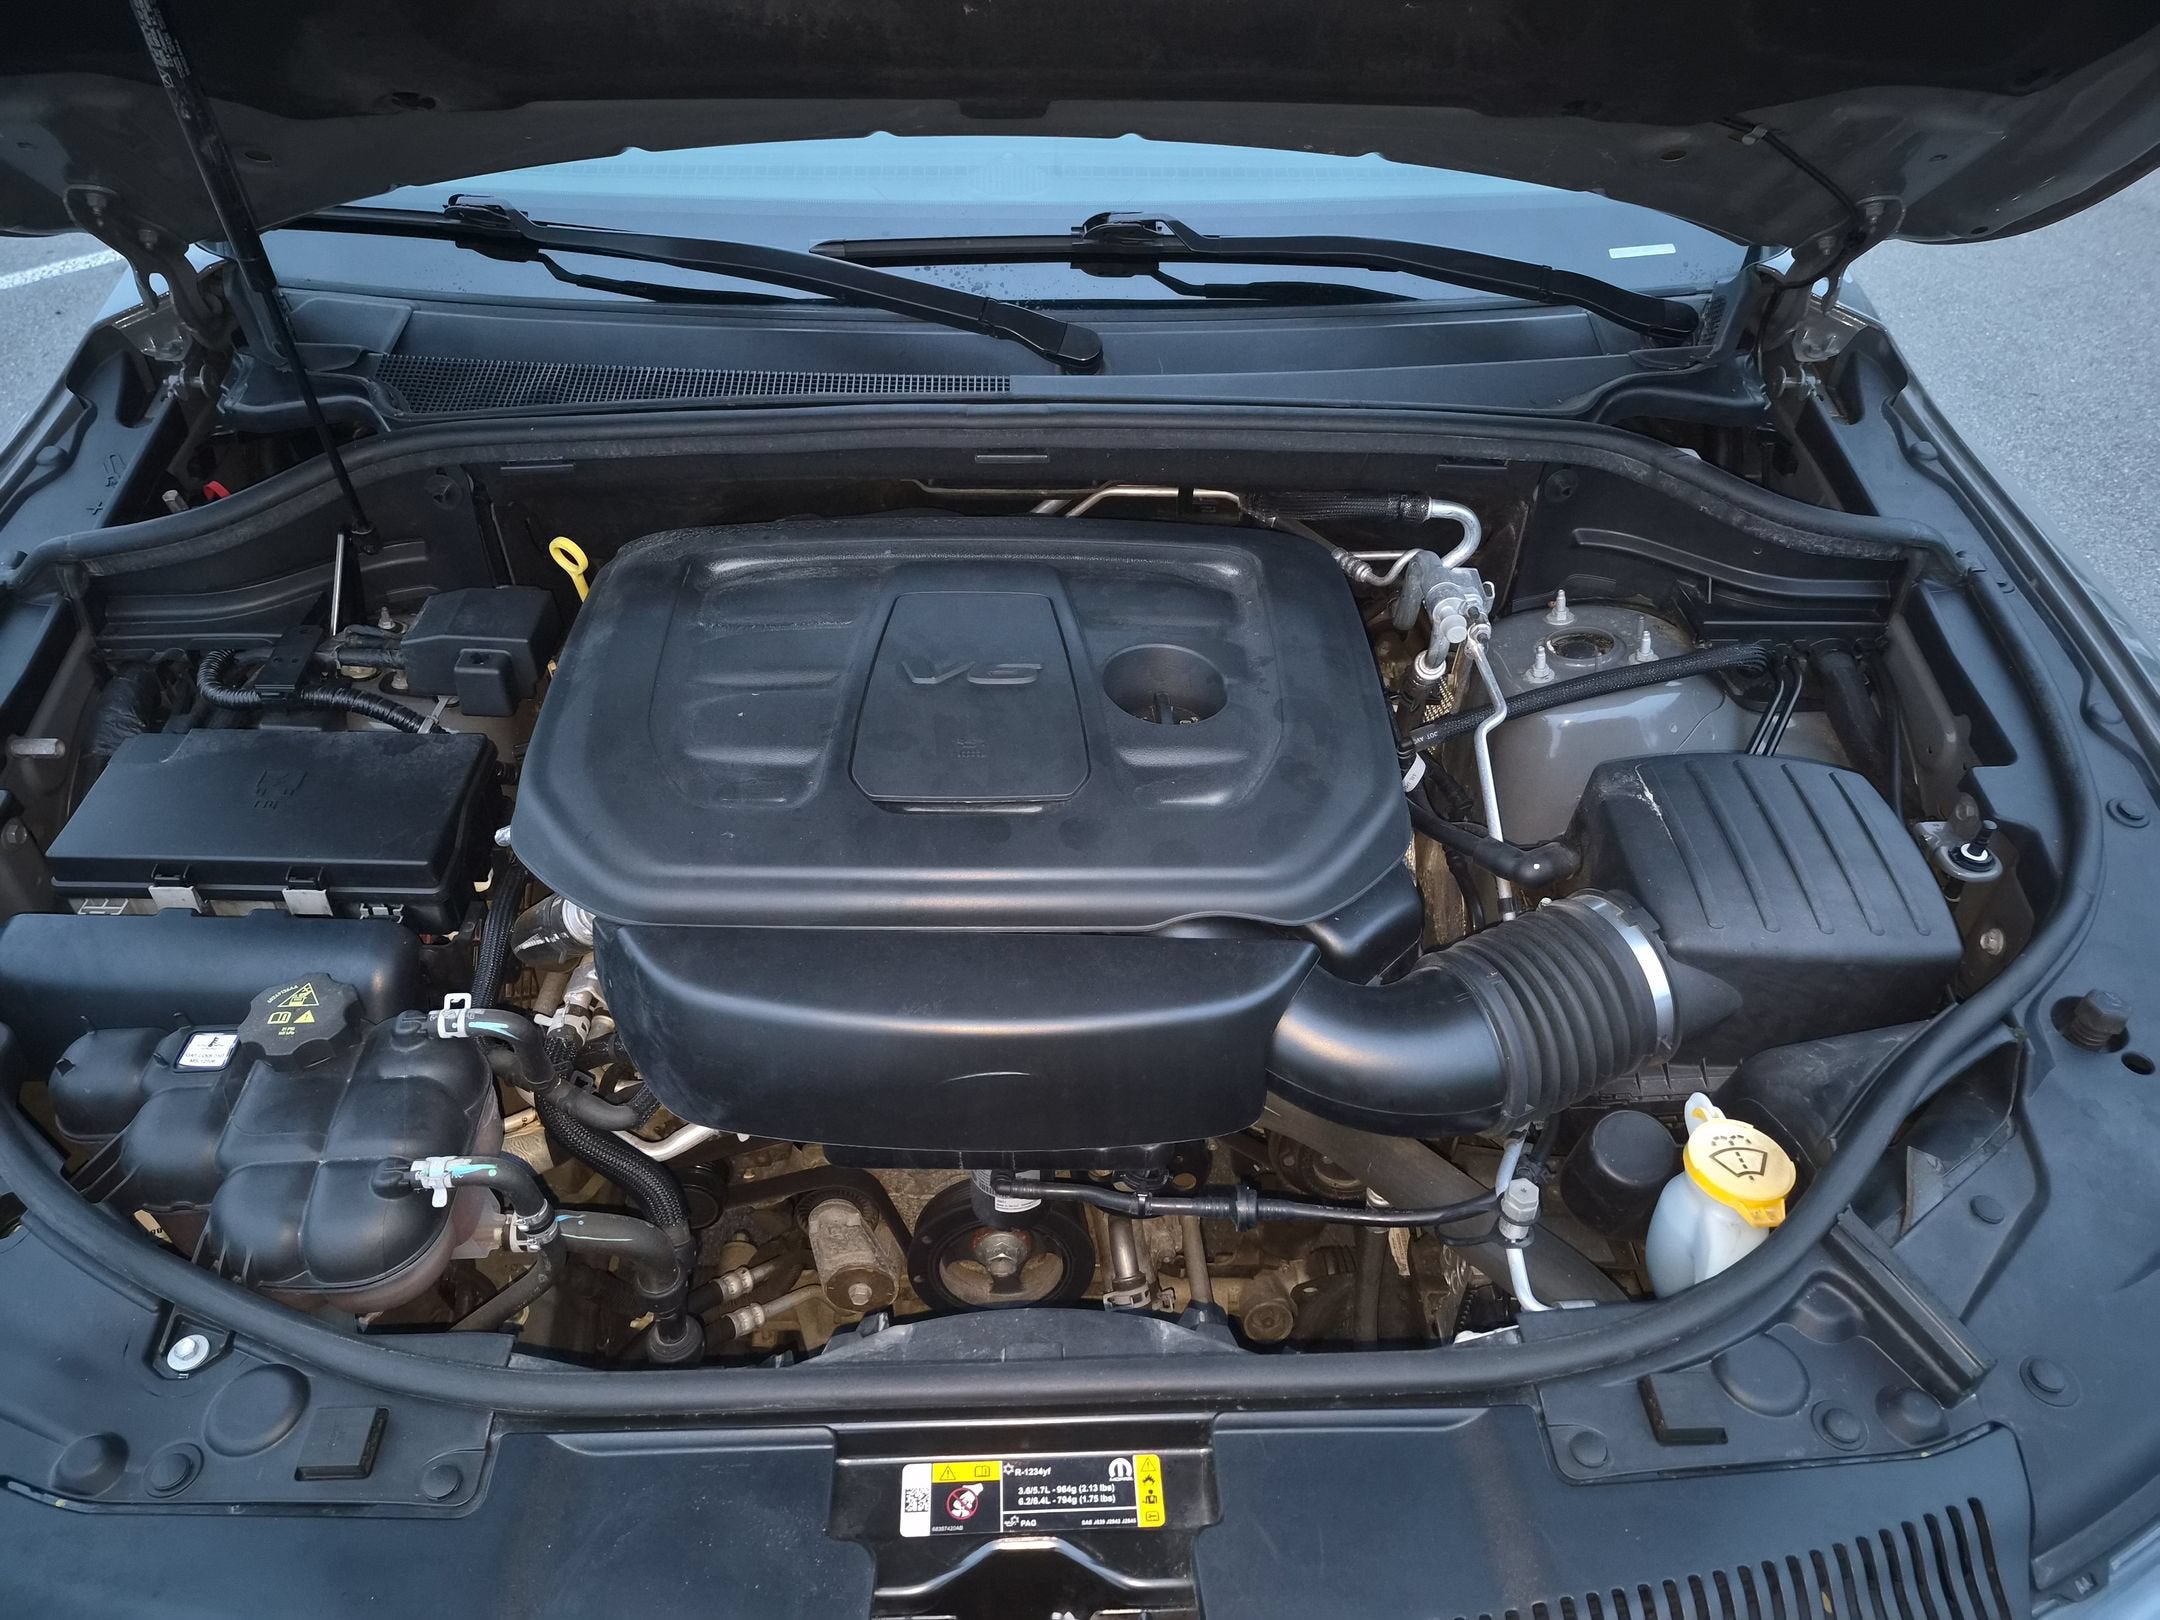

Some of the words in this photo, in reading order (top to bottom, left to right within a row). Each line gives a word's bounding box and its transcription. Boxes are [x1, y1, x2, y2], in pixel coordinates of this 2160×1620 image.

[902, 661, 1042, 685] V6
[1014, 1467, 1052, 1477] R-1234yf
[1017, 1486, 1051, 1495] 3.6/5.7L
[1079, 1483, 1099, 1494] (2.13
[1099, 1483, 1115, 1493] lbs)
[1017, 1496, 1051, 1506] 6.2/6.4L
[1056, 1496, 1078, 1505] 794g
[1079, 1495, 1099, 1505] (1.75
[1100, 1494, 1116, 1503] lbs)
[1020, 1519, 1037, 1527] PAG
